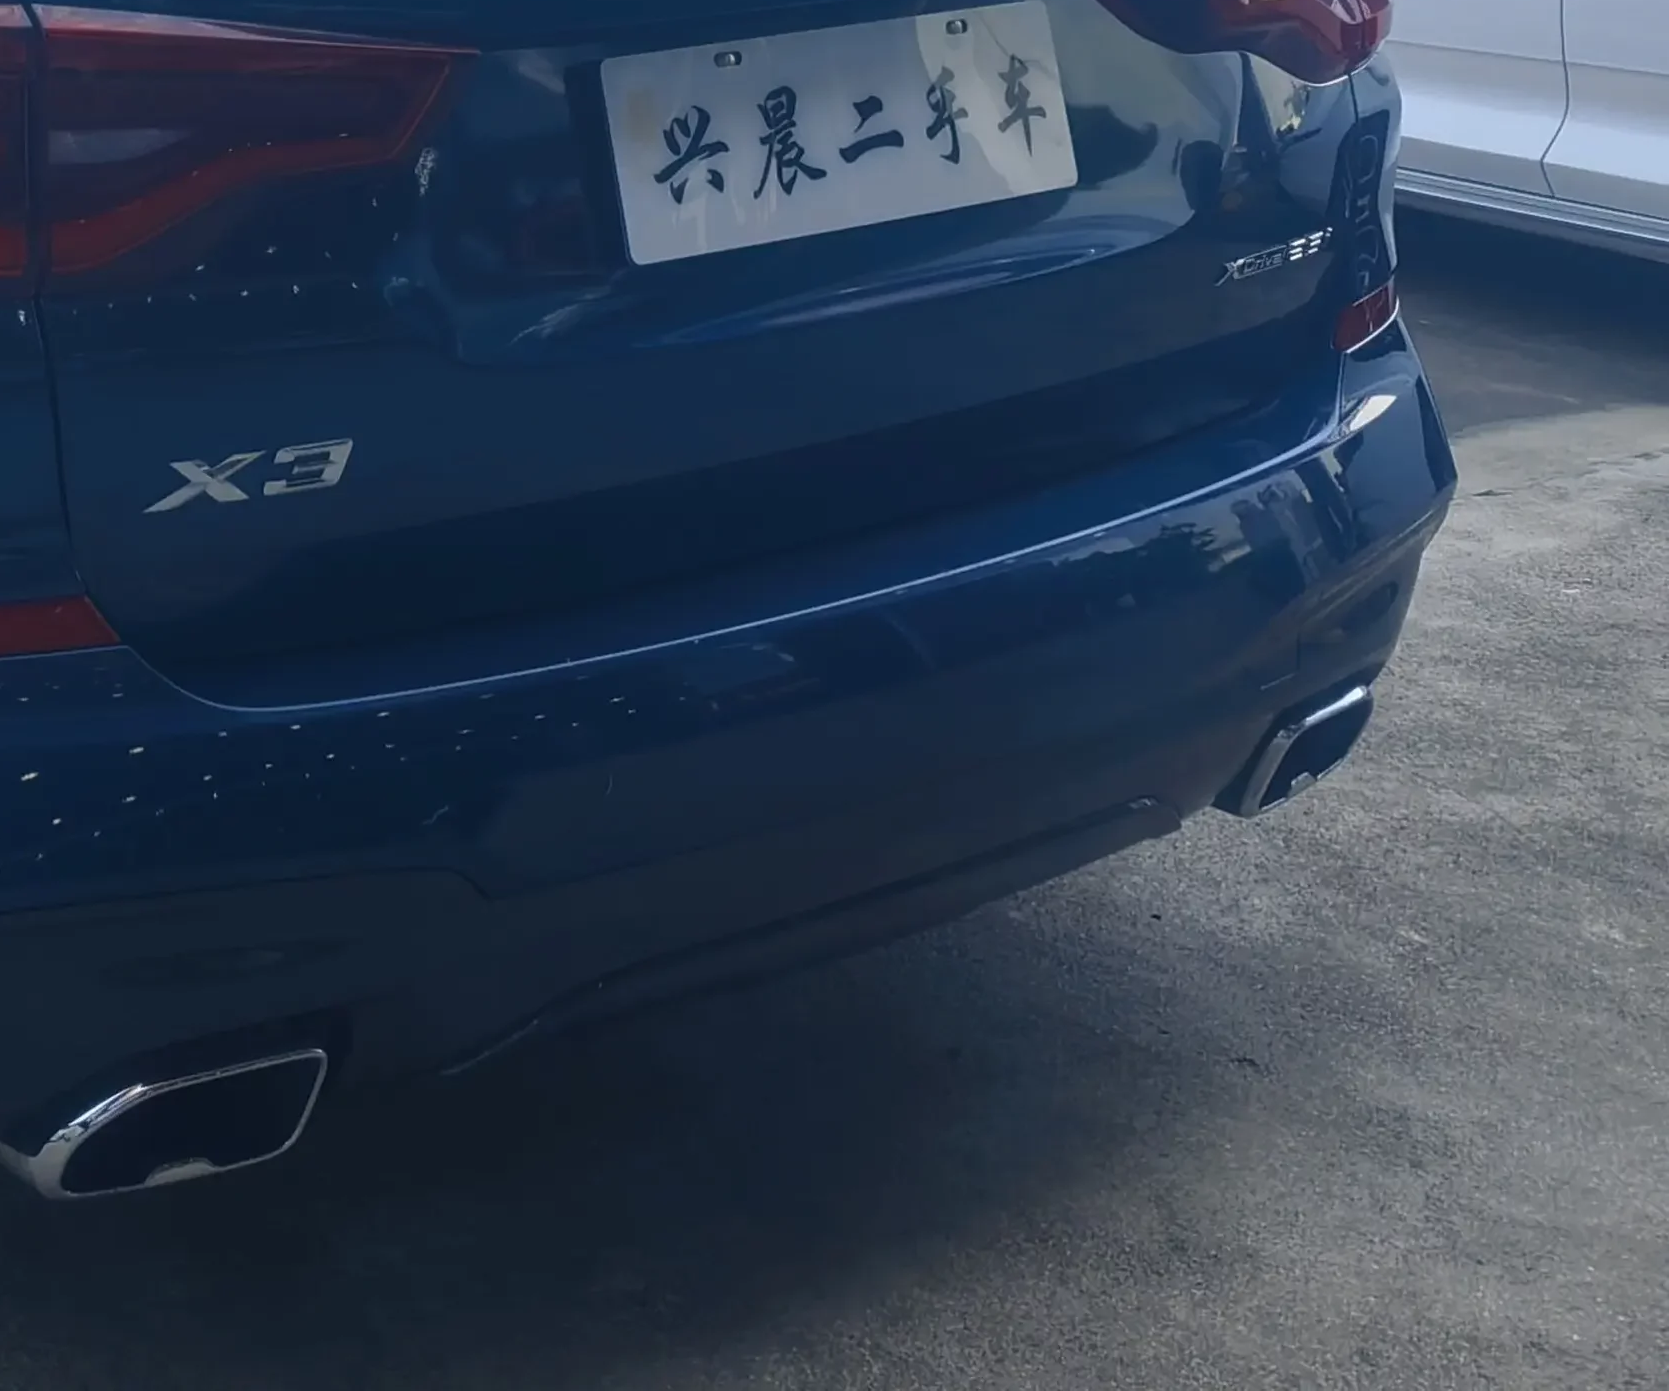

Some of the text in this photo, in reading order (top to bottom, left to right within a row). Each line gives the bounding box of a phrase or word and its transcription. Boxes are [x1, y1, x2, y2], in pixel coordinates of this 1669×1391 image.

[653, 53, 1047, 205] 兴晨二手车
[142, 437, 353, 514] X3
